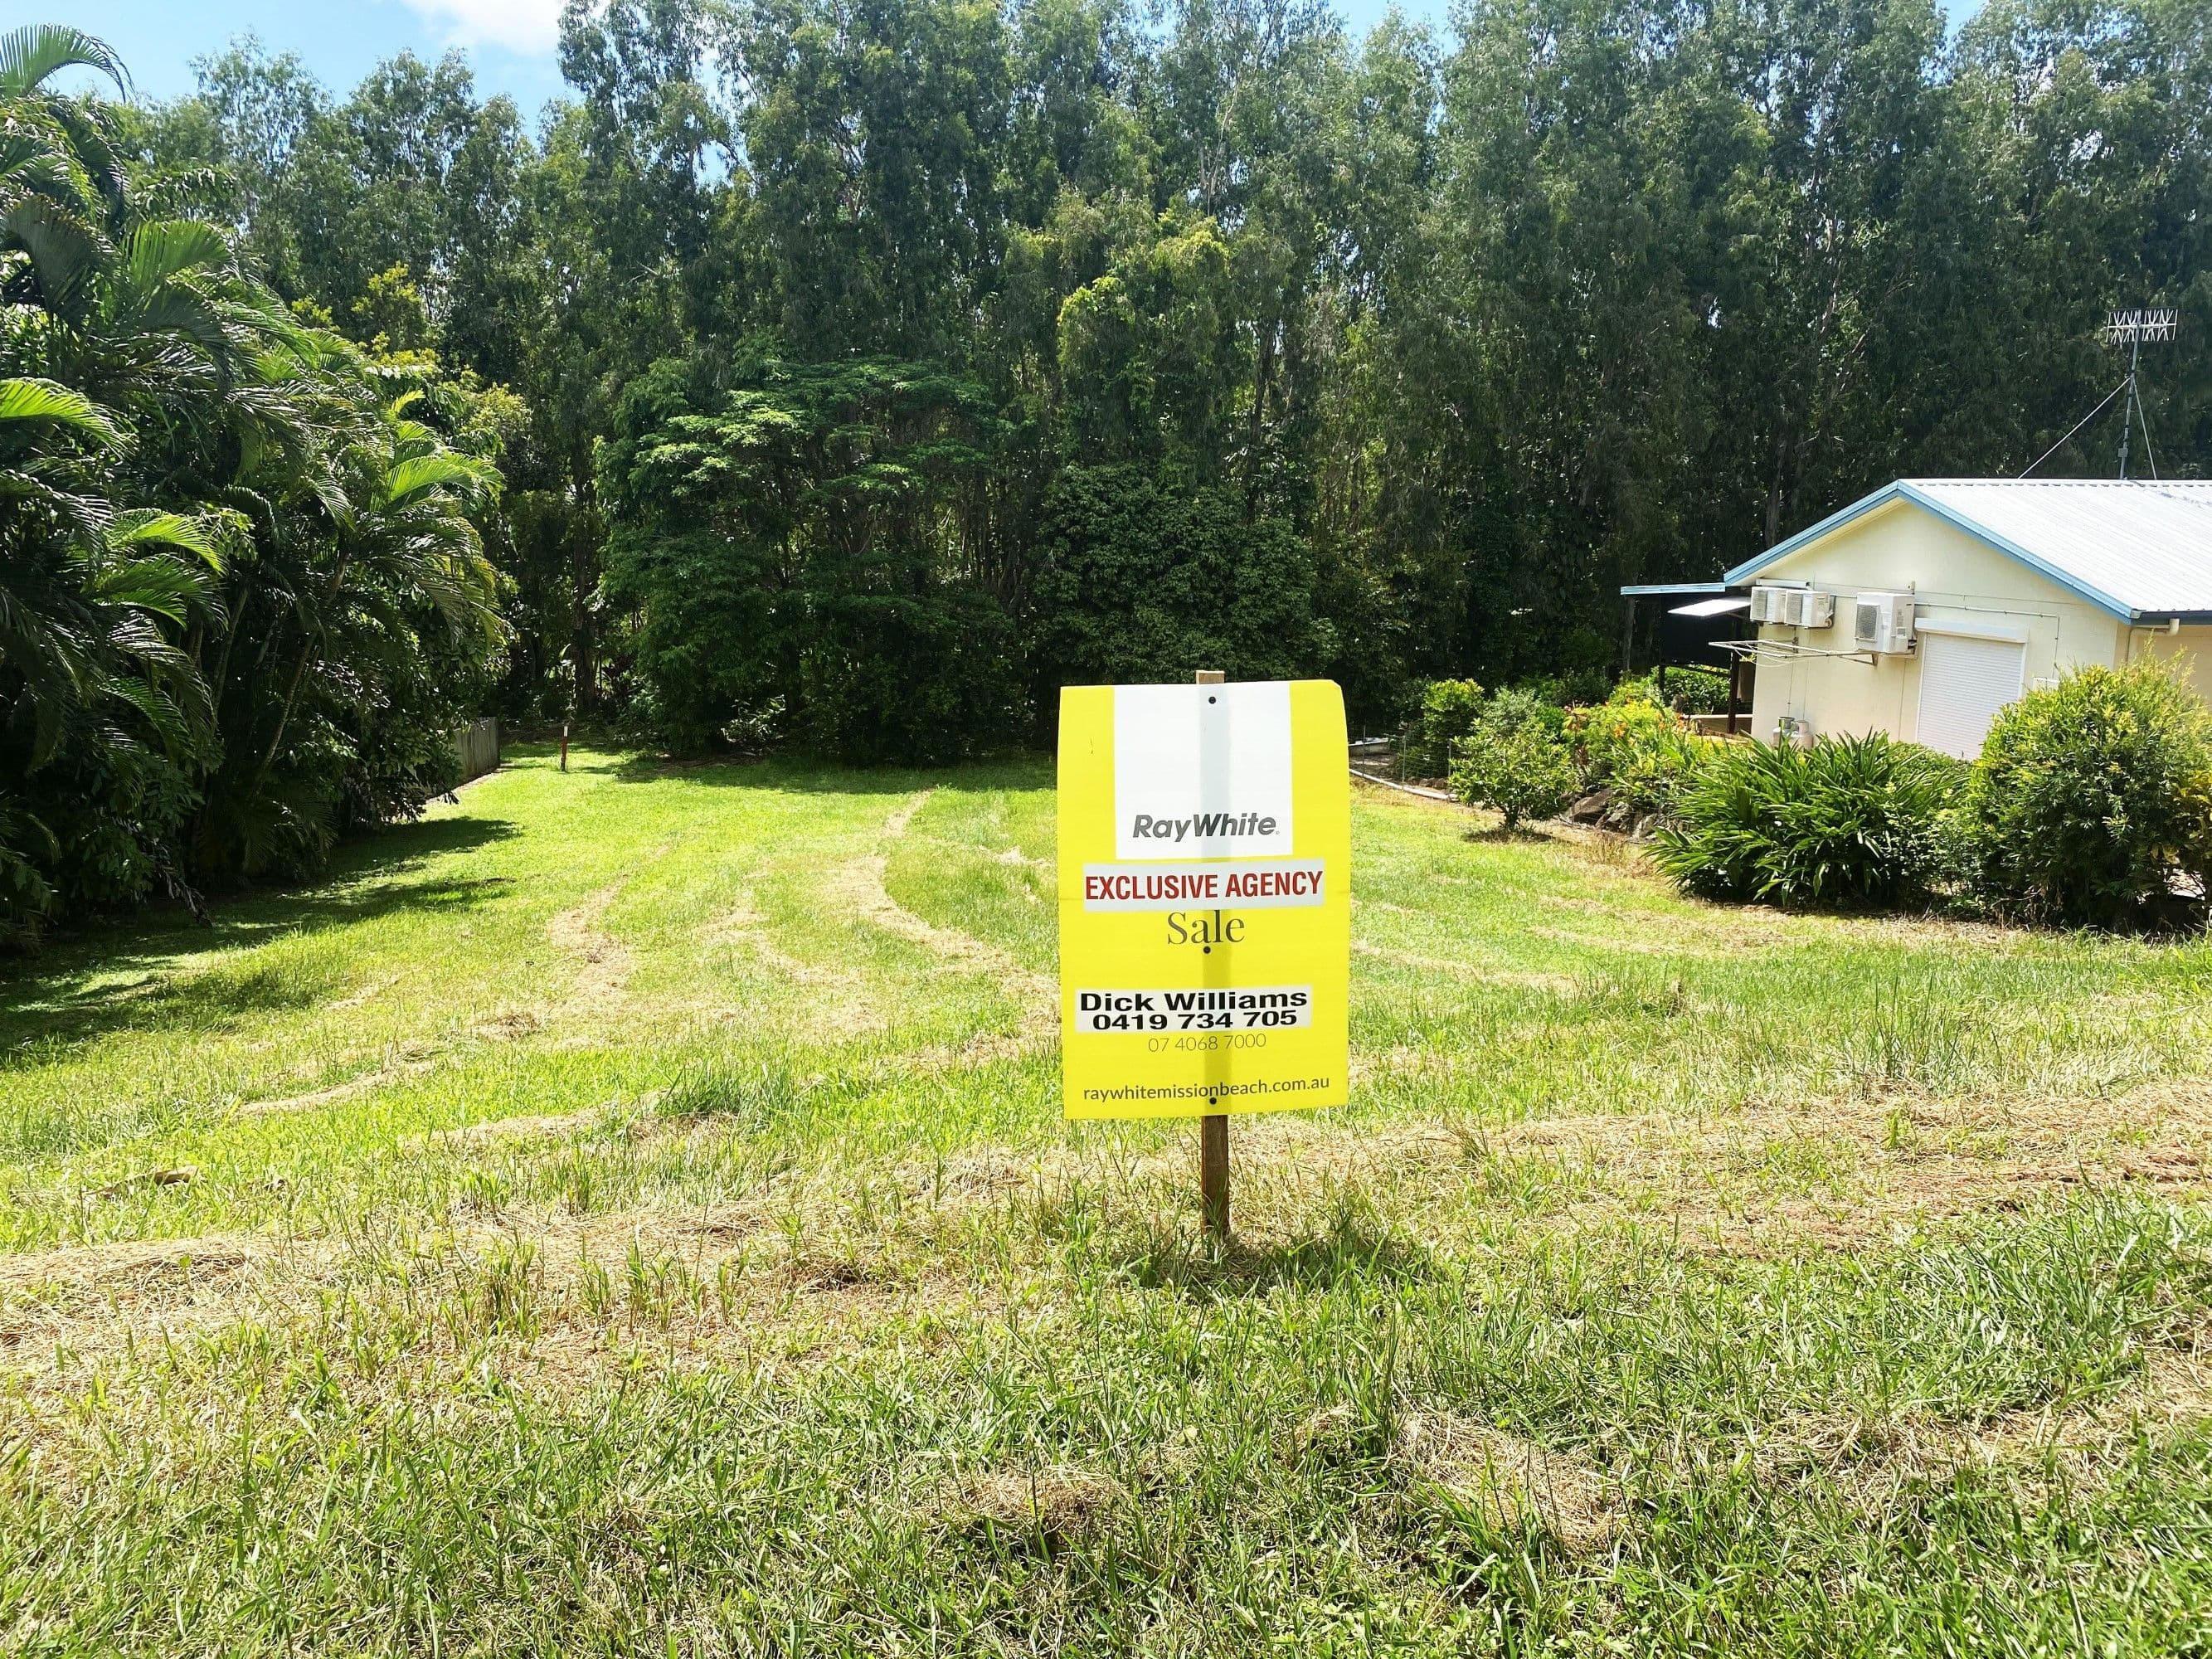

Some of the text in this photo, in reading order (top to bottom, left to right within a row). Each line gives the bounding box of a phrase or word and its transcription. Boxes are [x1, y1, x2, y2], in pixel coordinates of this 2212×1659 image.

[1132, 812, 1276, 843] RayWhite
[1086, 871, 1323, 900] EXCLUSIVE AGENCY
[1167, 909, 1245, 945] Sale
[1081, 991, 1308, 1012] Dick Williams
[1092, 1010, 1297, 1030] 0419 734 705
[1148, 1033, 1266, 1053] 07 4068 7000
[1083, 1077, 1330, 1103] raywhitemissionbeach.com.au
